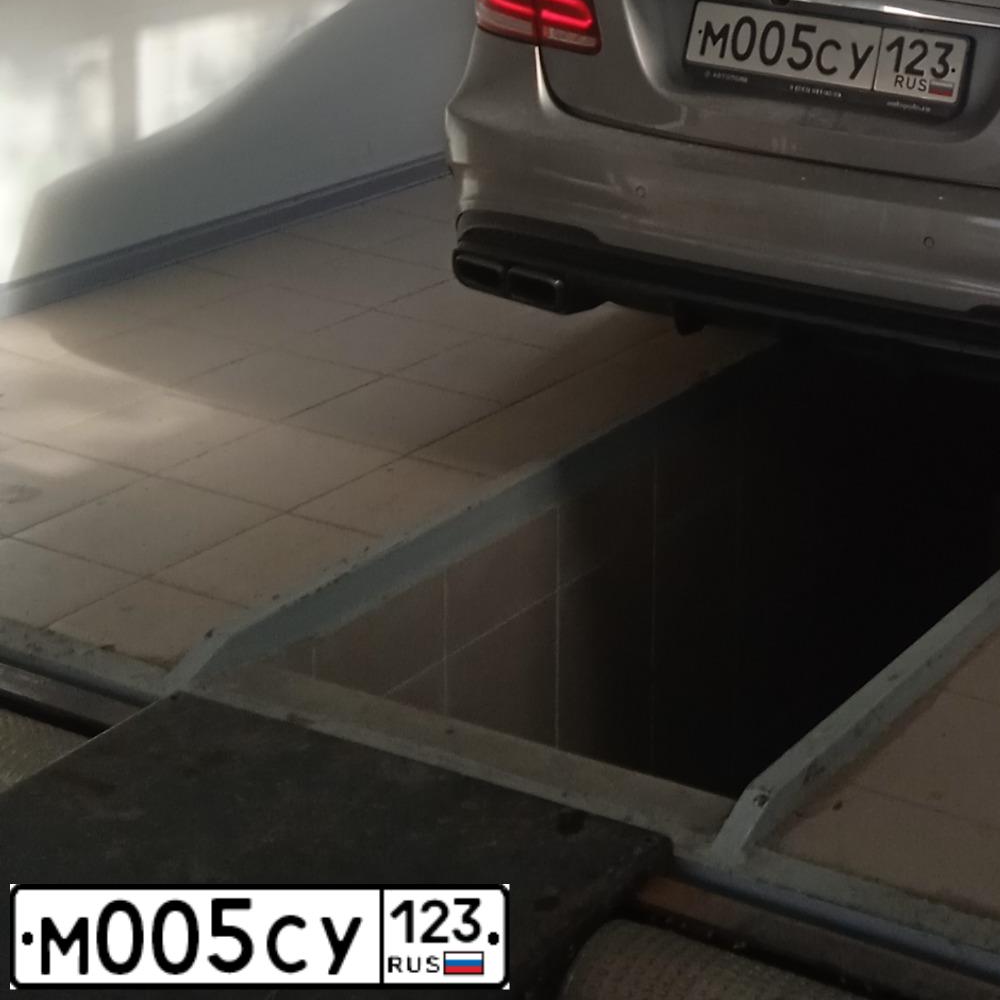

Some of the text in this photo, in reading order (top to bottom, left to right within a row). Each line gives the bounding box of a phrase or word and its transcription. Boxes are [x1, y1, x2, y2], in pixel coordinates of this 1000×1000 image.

[700, 16, 954, 80] М005СУ 123
[893, 74, 928, 92] RUS
